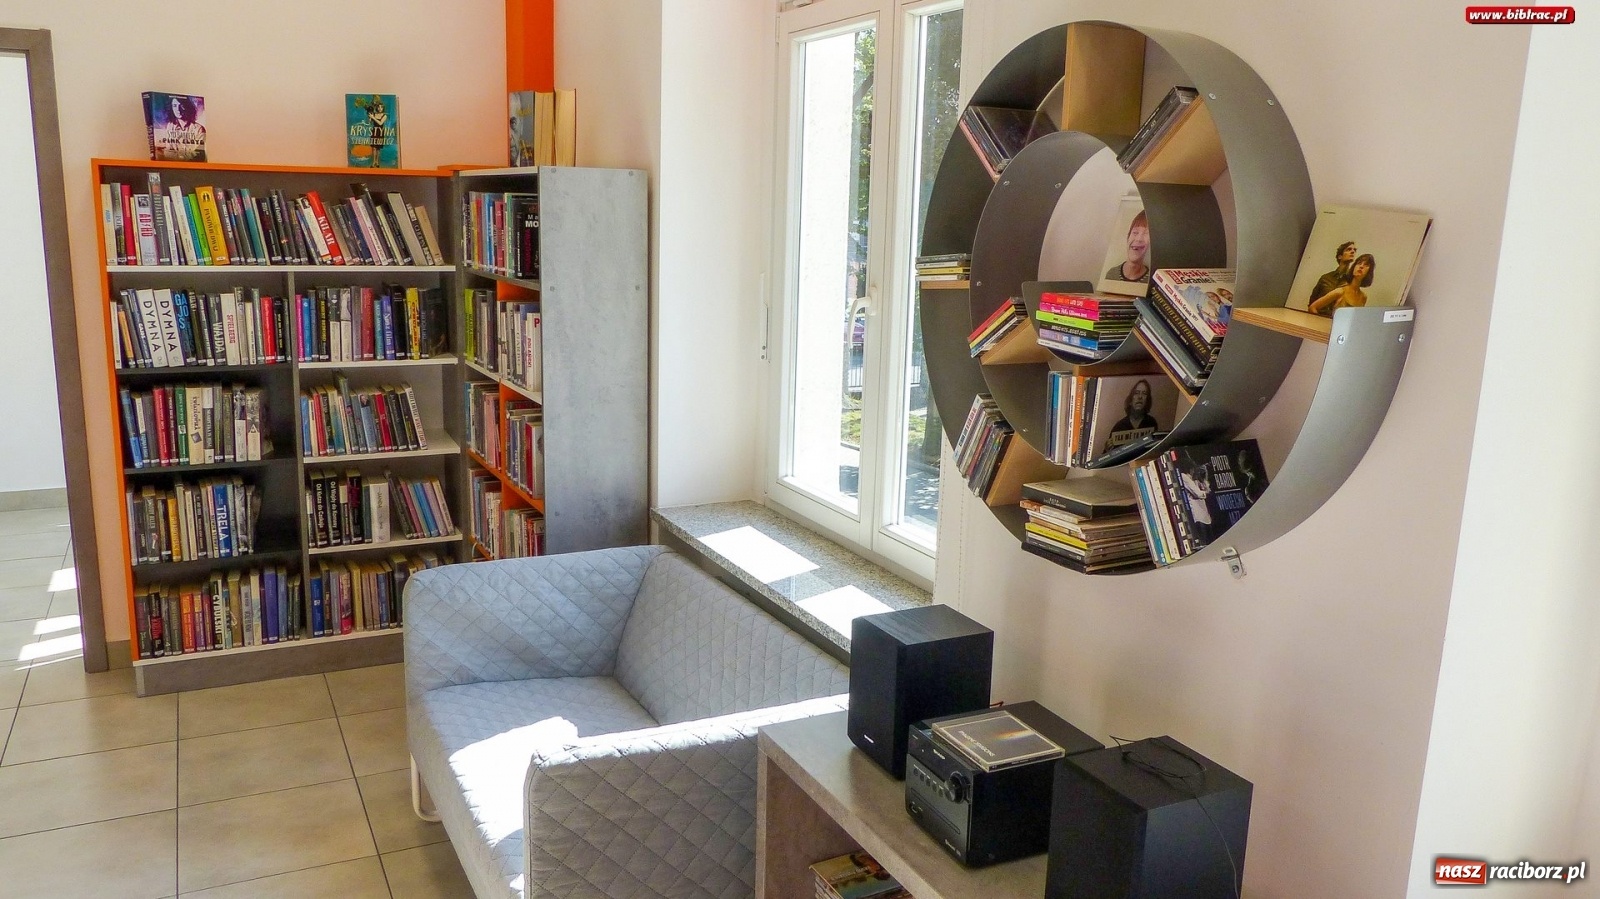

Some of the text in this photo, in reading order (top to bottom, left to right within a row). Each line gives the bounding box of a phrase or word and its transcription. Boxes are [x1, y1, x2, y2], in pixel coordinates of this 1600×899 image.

[350, 125, 395, 136] KRYSTYNA
[317, 215, 335, 245] KILAR
[142, 299, 162, 352] DYMNA
[158, 299, 178, 352] DYMNA
[212, 322, 225, 353] WAJDA
[226, 313, 236, 343] SPIELBERG
[1210, 454, 1231, 471] PIOTR
[1213, 472, 1237, 489] BARON
[214, 504, 230, 540] TRELA
[212, 594, 221, 633] CYBULSKI
